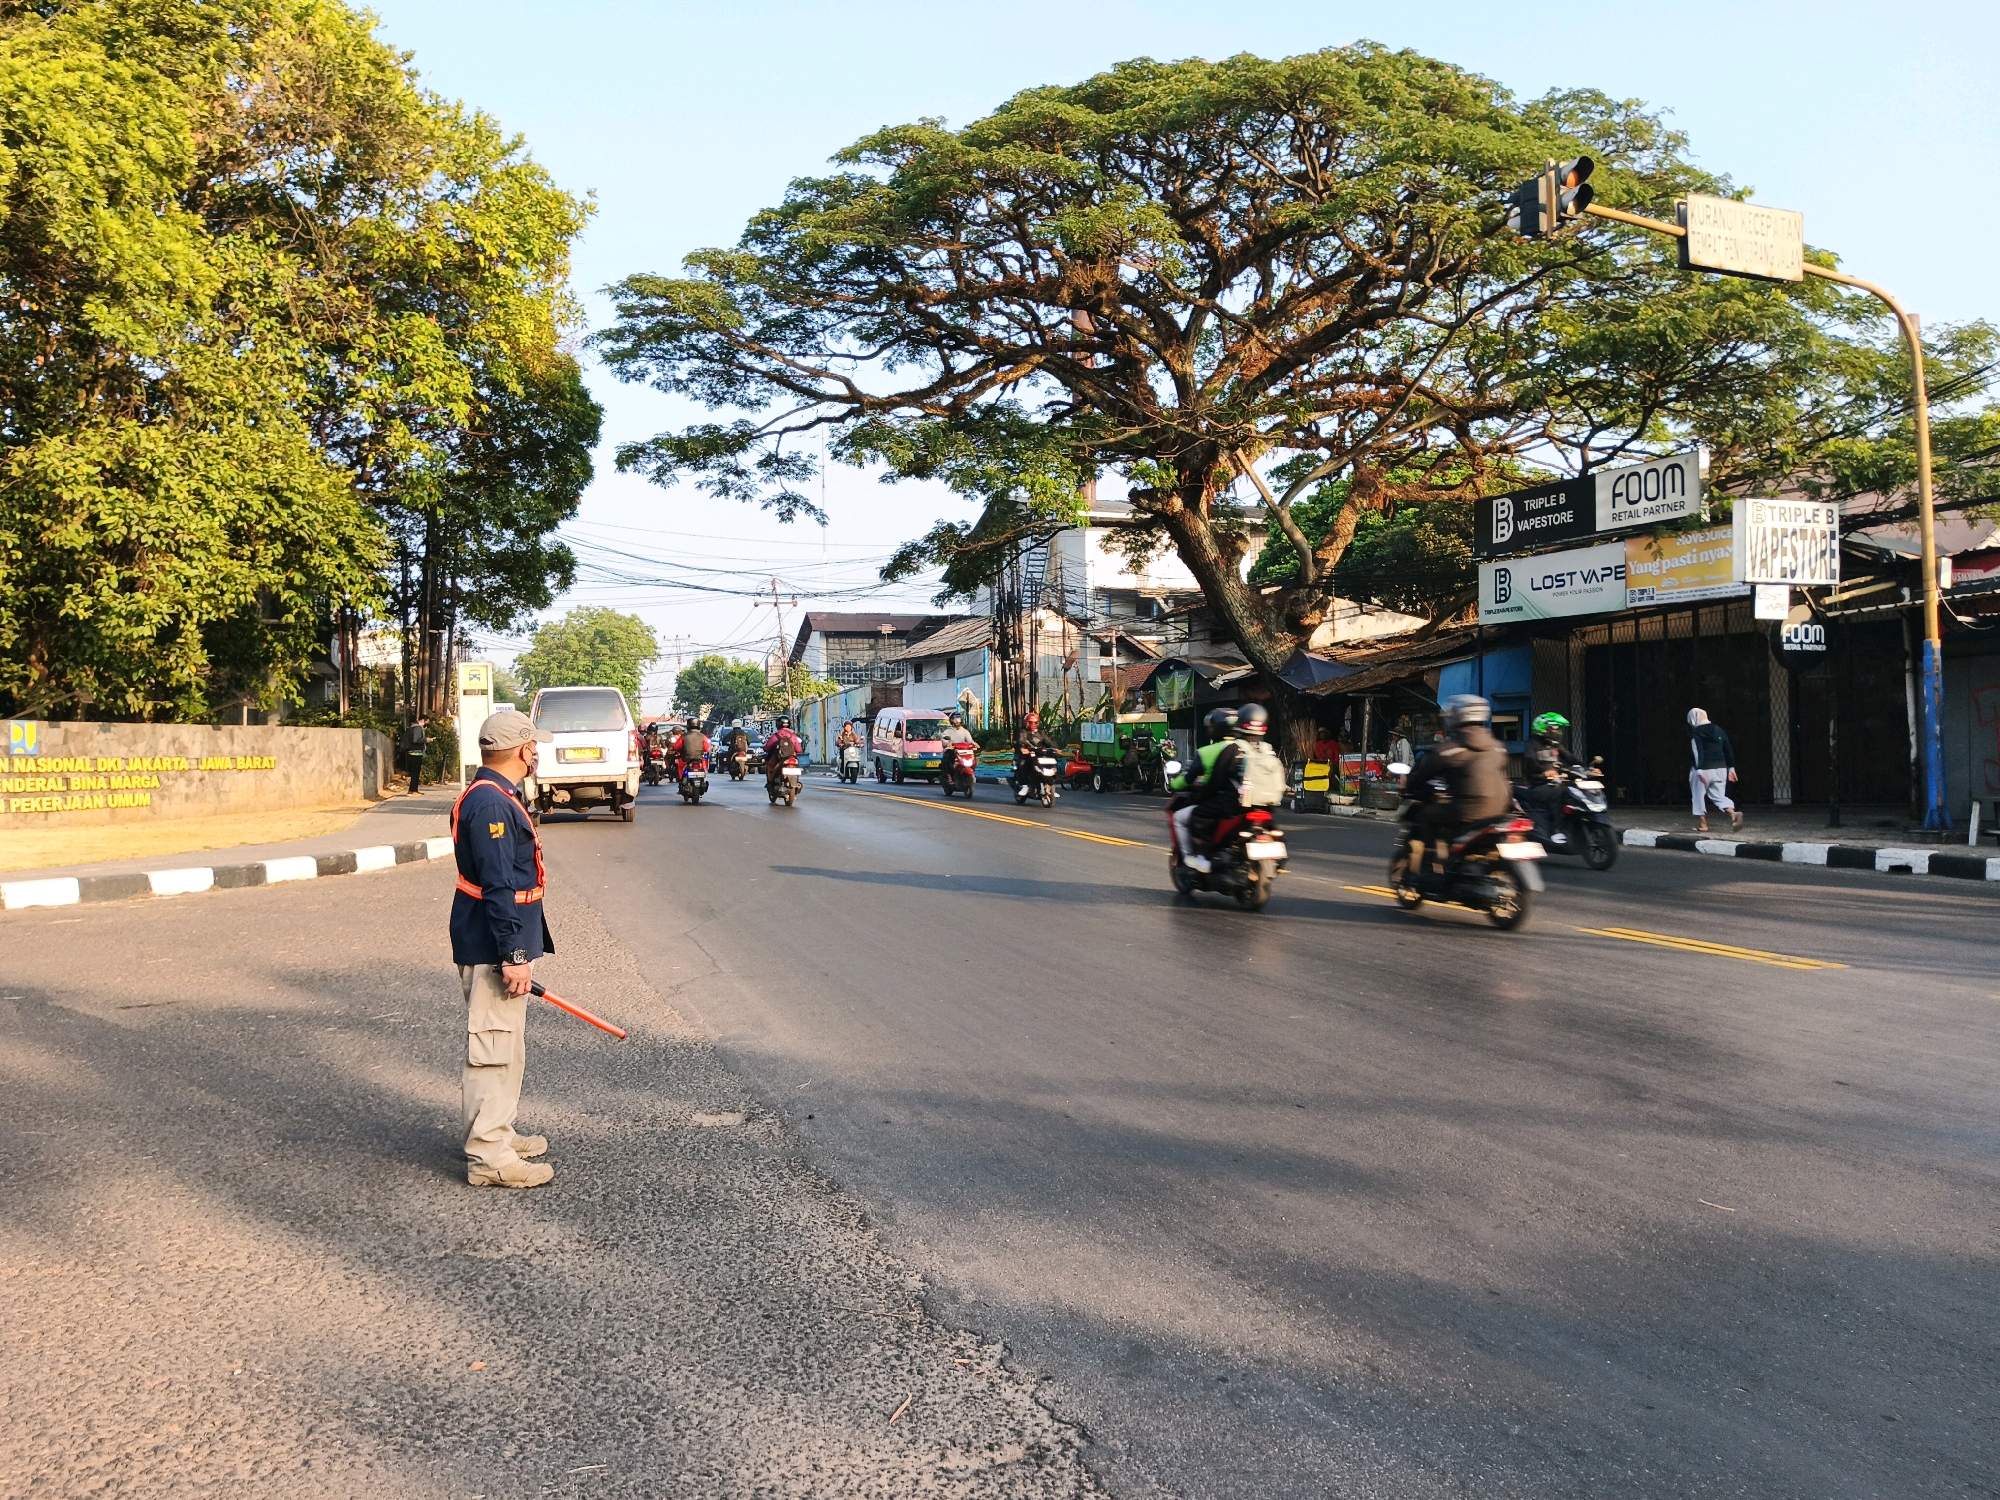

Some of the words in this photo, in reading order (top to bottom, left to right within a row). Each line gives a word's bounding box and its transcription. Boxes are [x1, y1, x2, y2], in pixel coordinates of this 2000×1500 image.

[1690, 202, 1738, 231] KURANGI
[1740, 211, 1801, 242] KECEPATAN
[1691, 230, 1722, 256] TEMPAT
[1612, 462, 1685, 509] FOOM
[1524, 495, 1557, 512] TRIPLE
[1558, 492, 1566, 505] B
[1611, 508, 1641, 523] RETAIL
[1643, 500, 1686, 518] PARTNER
[1517, 510, 1574, 532] VAPESTORE
[1768, 505, 1820, 524] TRIPLE
[1826, 508, 1835, 524] B
[1628, 558, 1661, 576] Yang
[1662, 548, 1698, 574] pasti
[1749, 526, 1837, 580] VAPESTORE
[1530, 571, 1577, 592] LOST
[1580, 564, 1626, 585] VAPE
[1569, 588, 1582, 596] YOUR
[1583, 586, 1604, 595] PASSION
[1782, 623, 1825, 644] FOOM
[1783, 643, 1802, 651] RETAIL
[1802, 643, 1827, 651] PARTNER
[13, 757, 95, 773] NASIONAL
[97, 757, 122, 772] DKI
[125, 757, 188, 772] JAKARTA
[199, 756, 232, 771] JAWA
[236, 755, 277, 770] BARAT
[0, 776, 67, 793] NDERAL
[70, 776, 108, 791] BINA
[110, 774, 161, 790] MARGA
[9, 794, 104, 813] PEKERJAAN
[107, 792, 151, 808] UMUM
